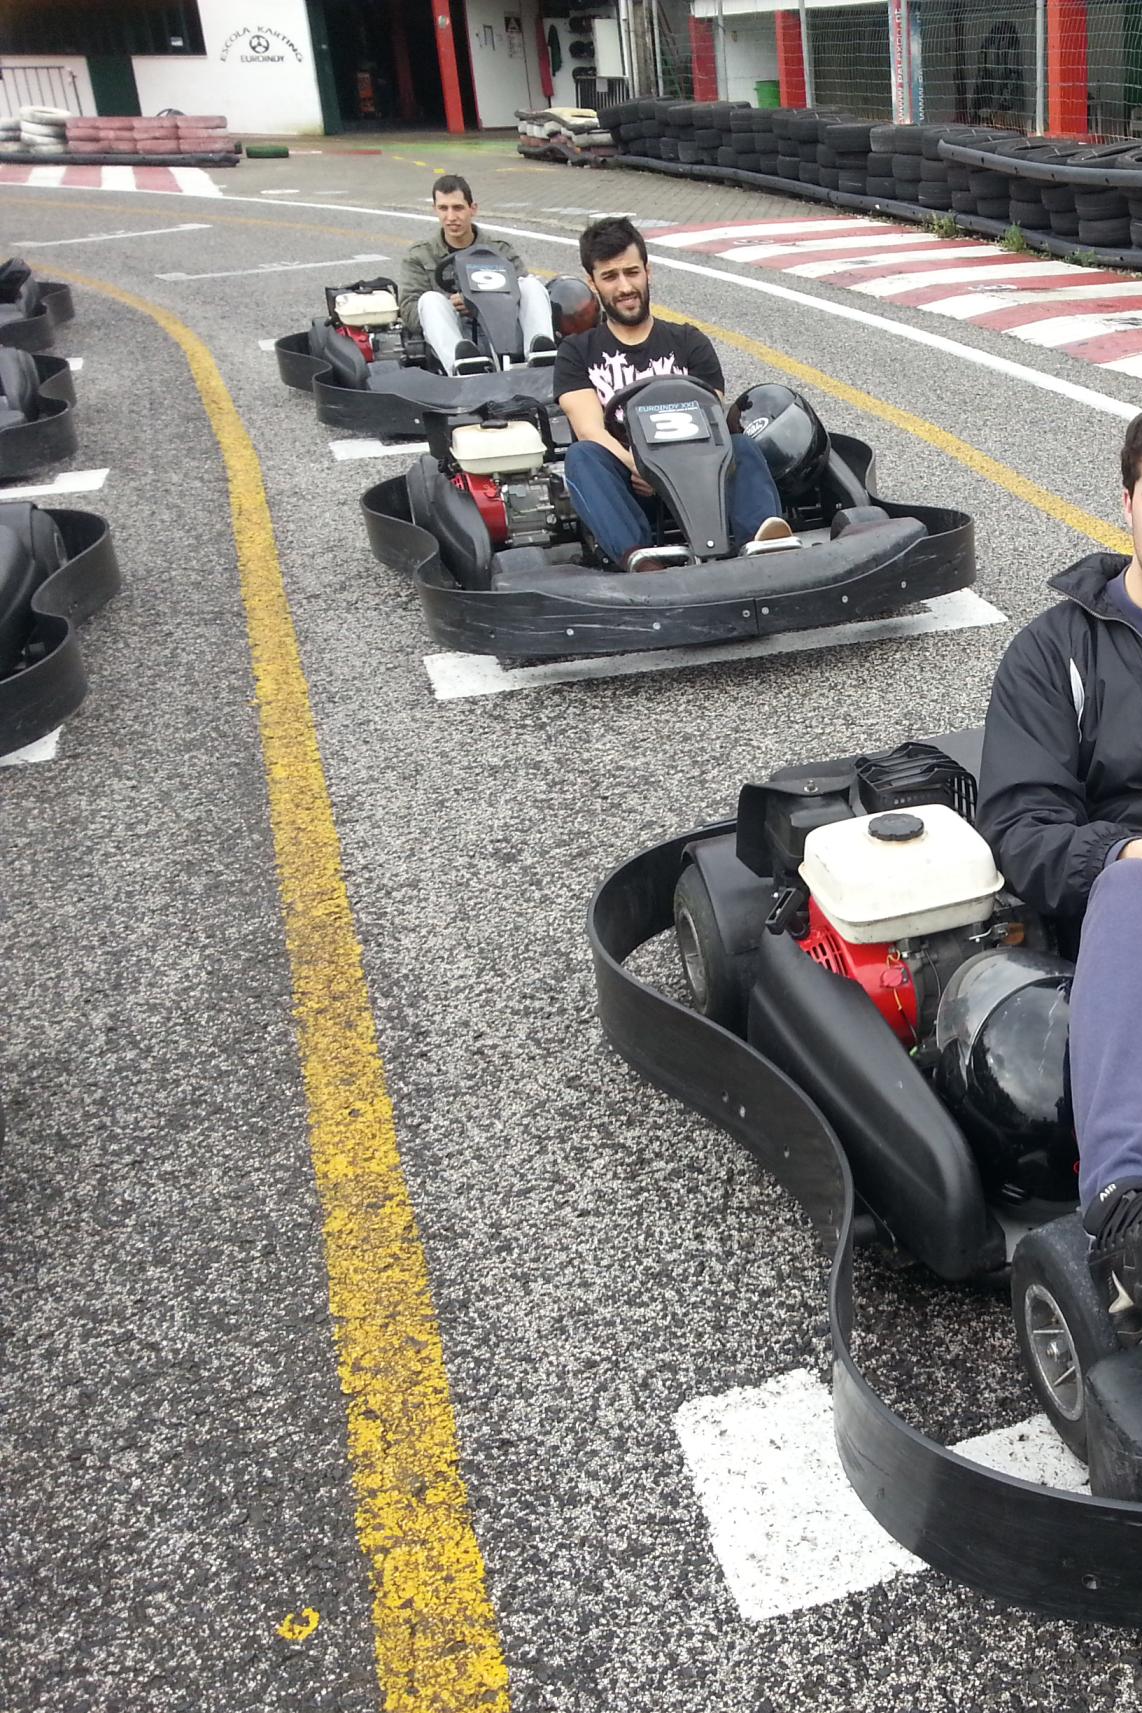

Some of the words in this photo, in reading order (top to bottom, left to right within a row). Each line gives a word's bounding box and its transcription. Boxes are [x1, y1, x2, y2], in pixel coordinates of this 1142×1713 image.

[219, 26, 251, 62] ESCOLA
[257, 26, 304, 63] KARTING
[240, 54, 285, 63] EUROINDY
[470, 270, 506, 290] 9
[649, 412, 699, 439] 3
[1099, 1183, 1117, 1203] AIR
